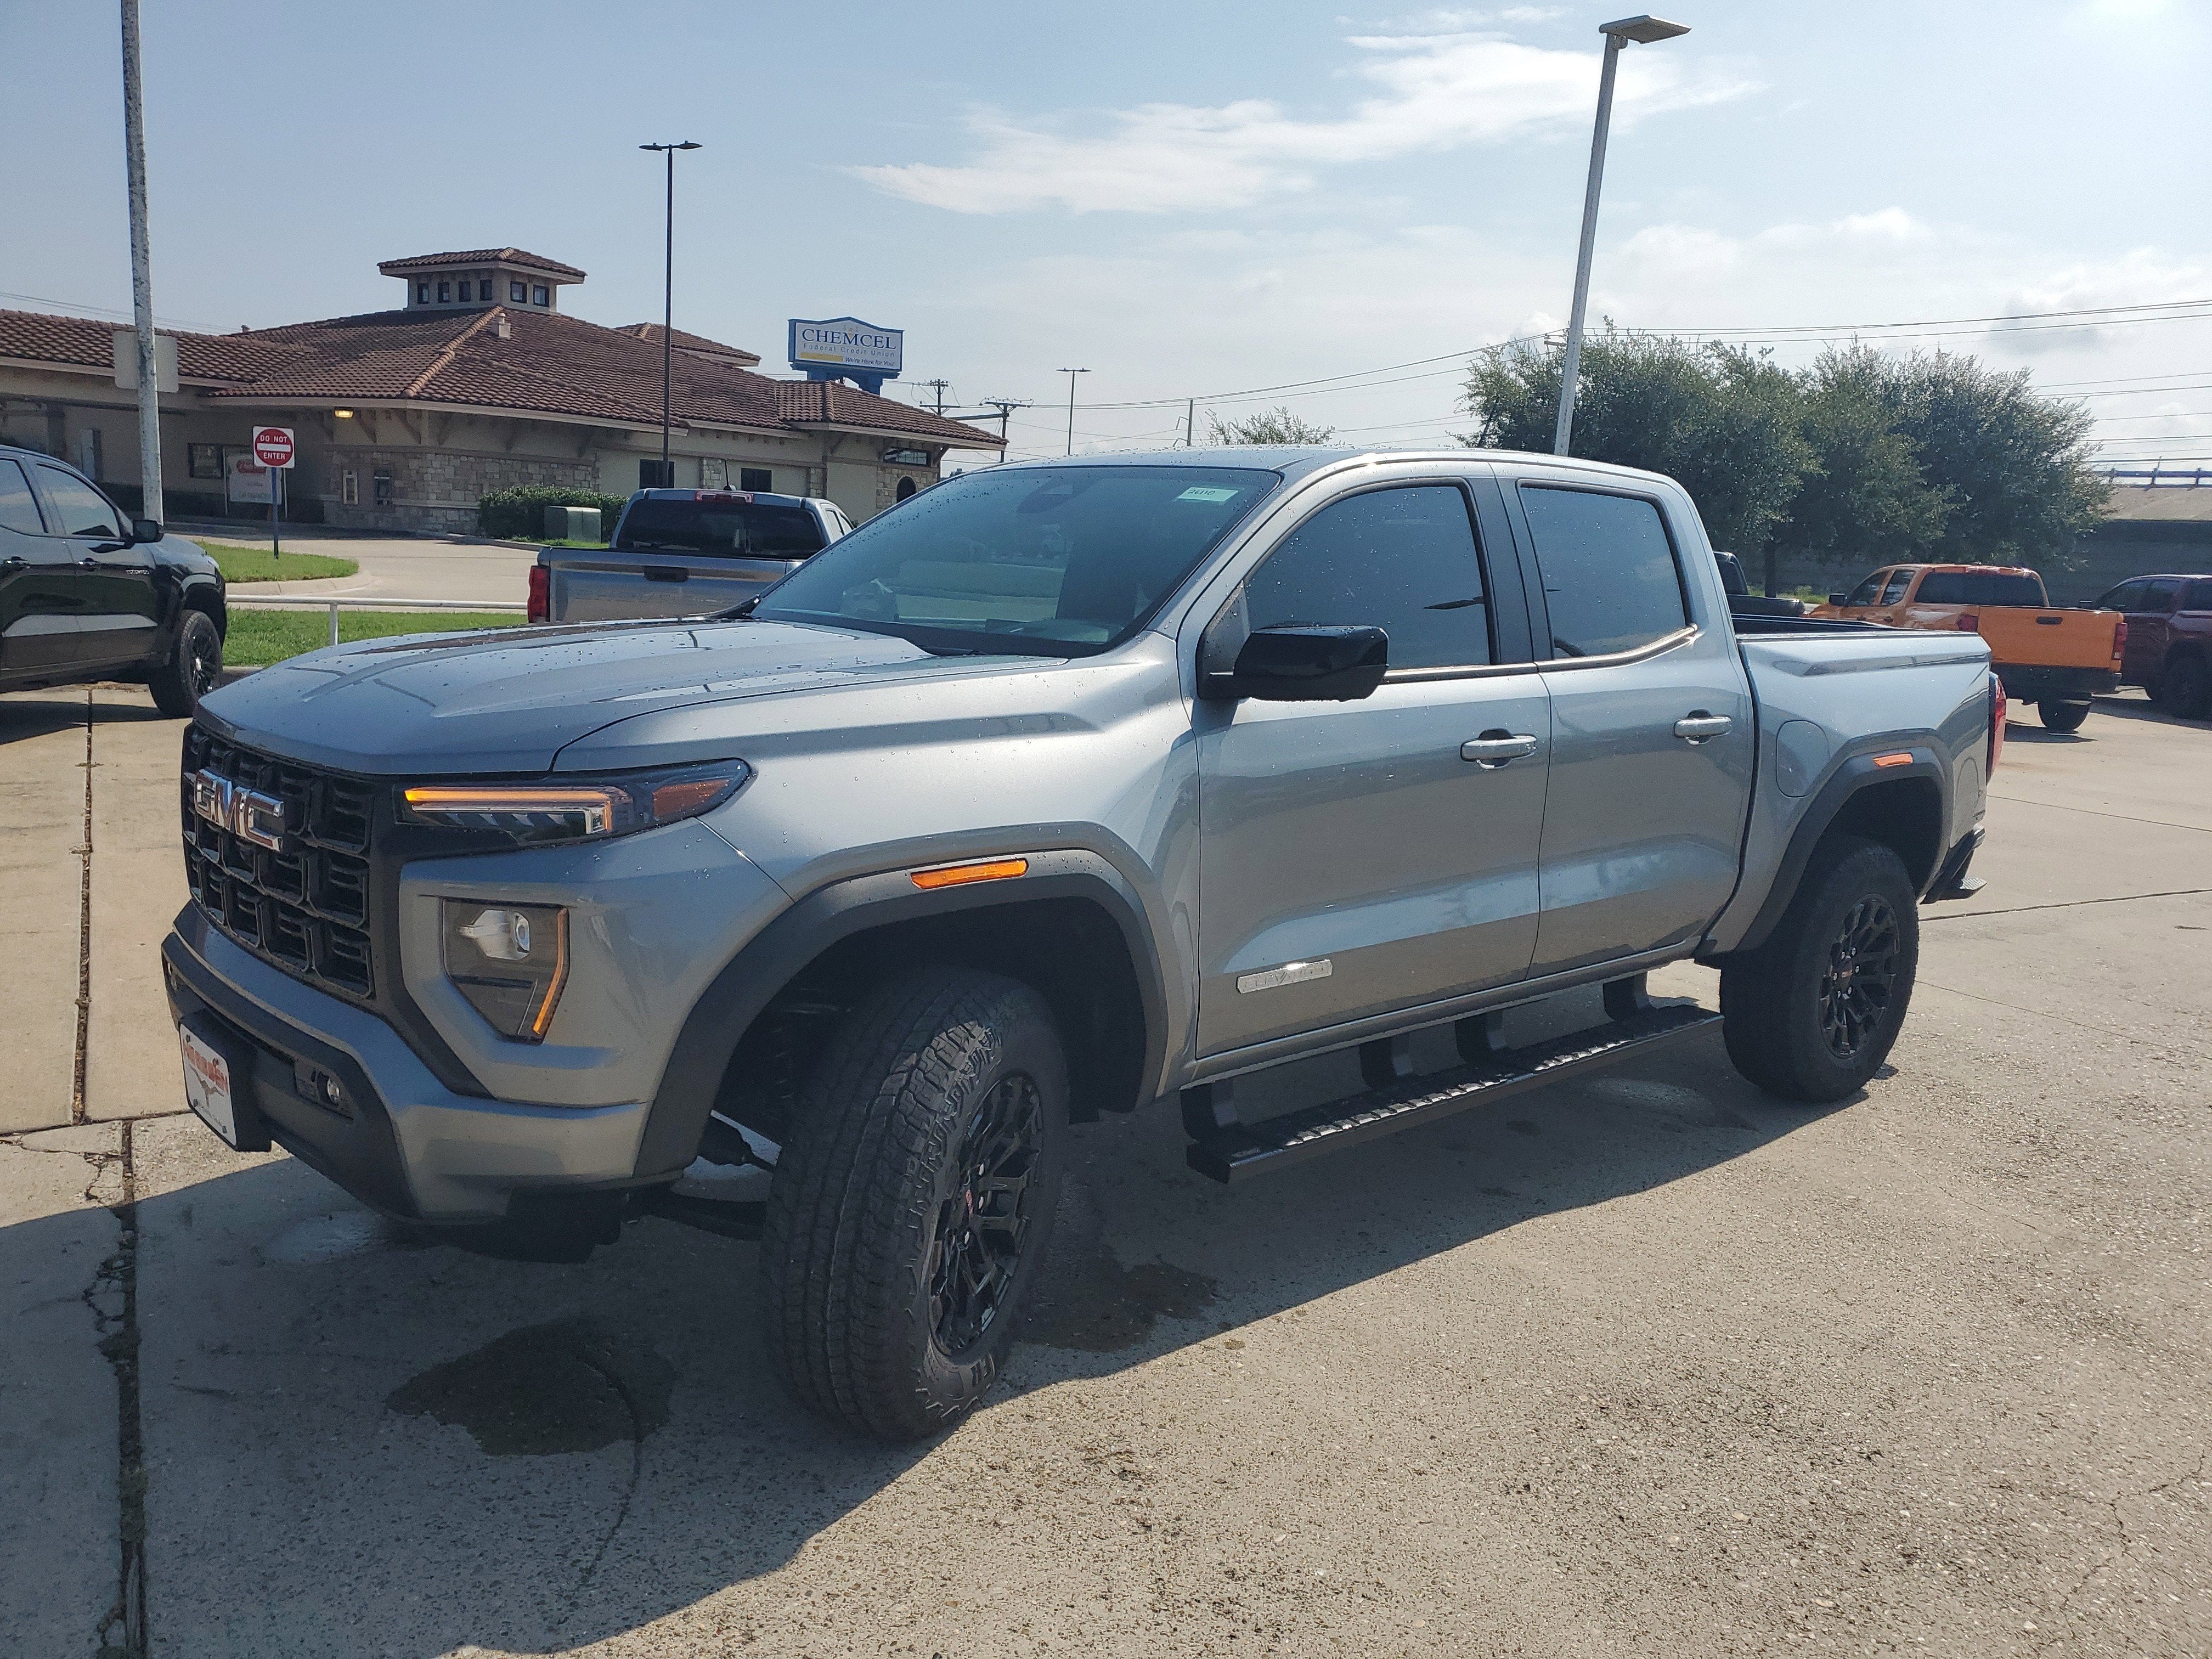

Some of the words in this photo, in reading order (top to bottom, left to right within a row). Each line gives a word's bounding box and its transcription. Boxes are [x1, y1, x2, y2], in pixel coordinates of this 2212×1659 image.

[802, 329, 896, 349] CHEMCEL
[804, 343, 836, 352] Federal
[840, 347, 866, 356] Credit
[871, 349, 895, 358] Union
[194, 769, 284, 852] GMC
